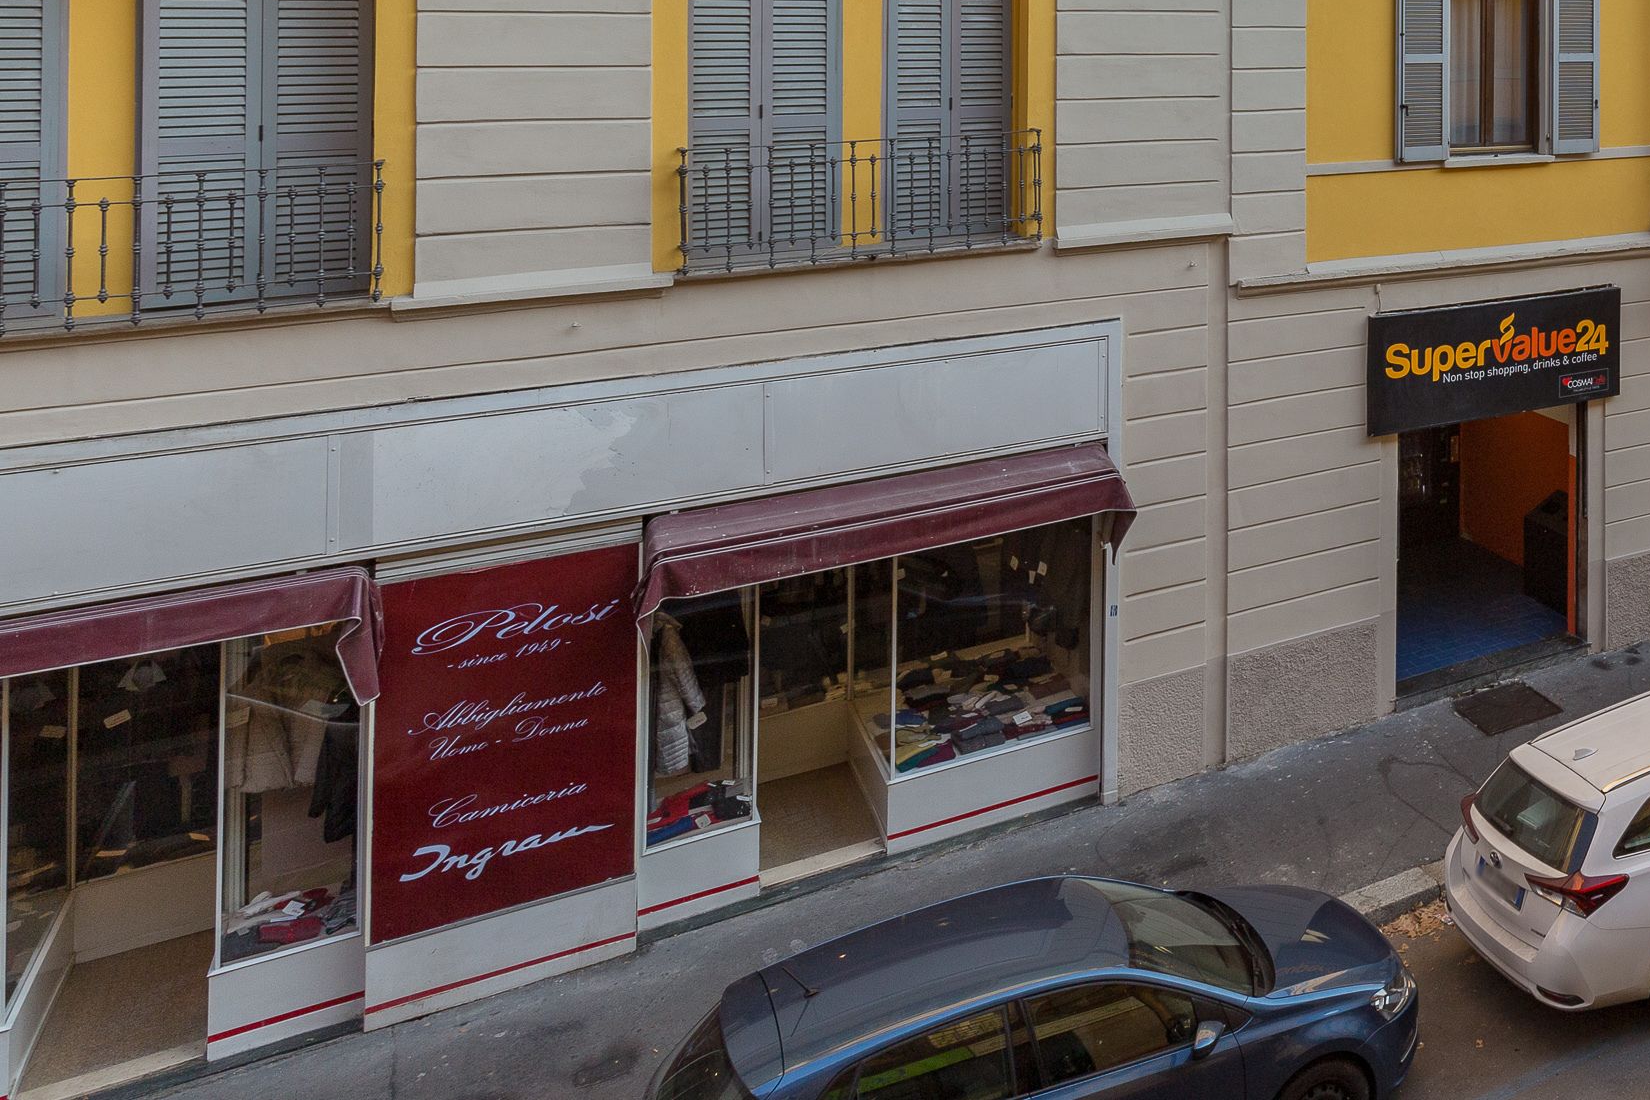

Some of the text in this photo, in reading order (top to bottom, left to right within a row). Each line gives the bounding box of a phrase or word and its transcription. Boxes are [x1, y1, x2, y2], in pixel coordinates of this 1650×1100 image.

[1442, 371, 1463, 384] Non
[1465, 368, 1485, 381] stop
[1533, 357, 1561, 370] drinks
[1563, 355, 1570, 365] &
[1571, 352, 1598, 364] coffee
[411, 598, 619, 656] Pelosi
[514, 638, 562, 659] 1949
[407, 680, 608, 736] Abbigliamento
[428, 716, 589, 762] Uomo Donna
[427, 782, 588, 830] Camiceria
[399, 823, 615, 883] Ingram
